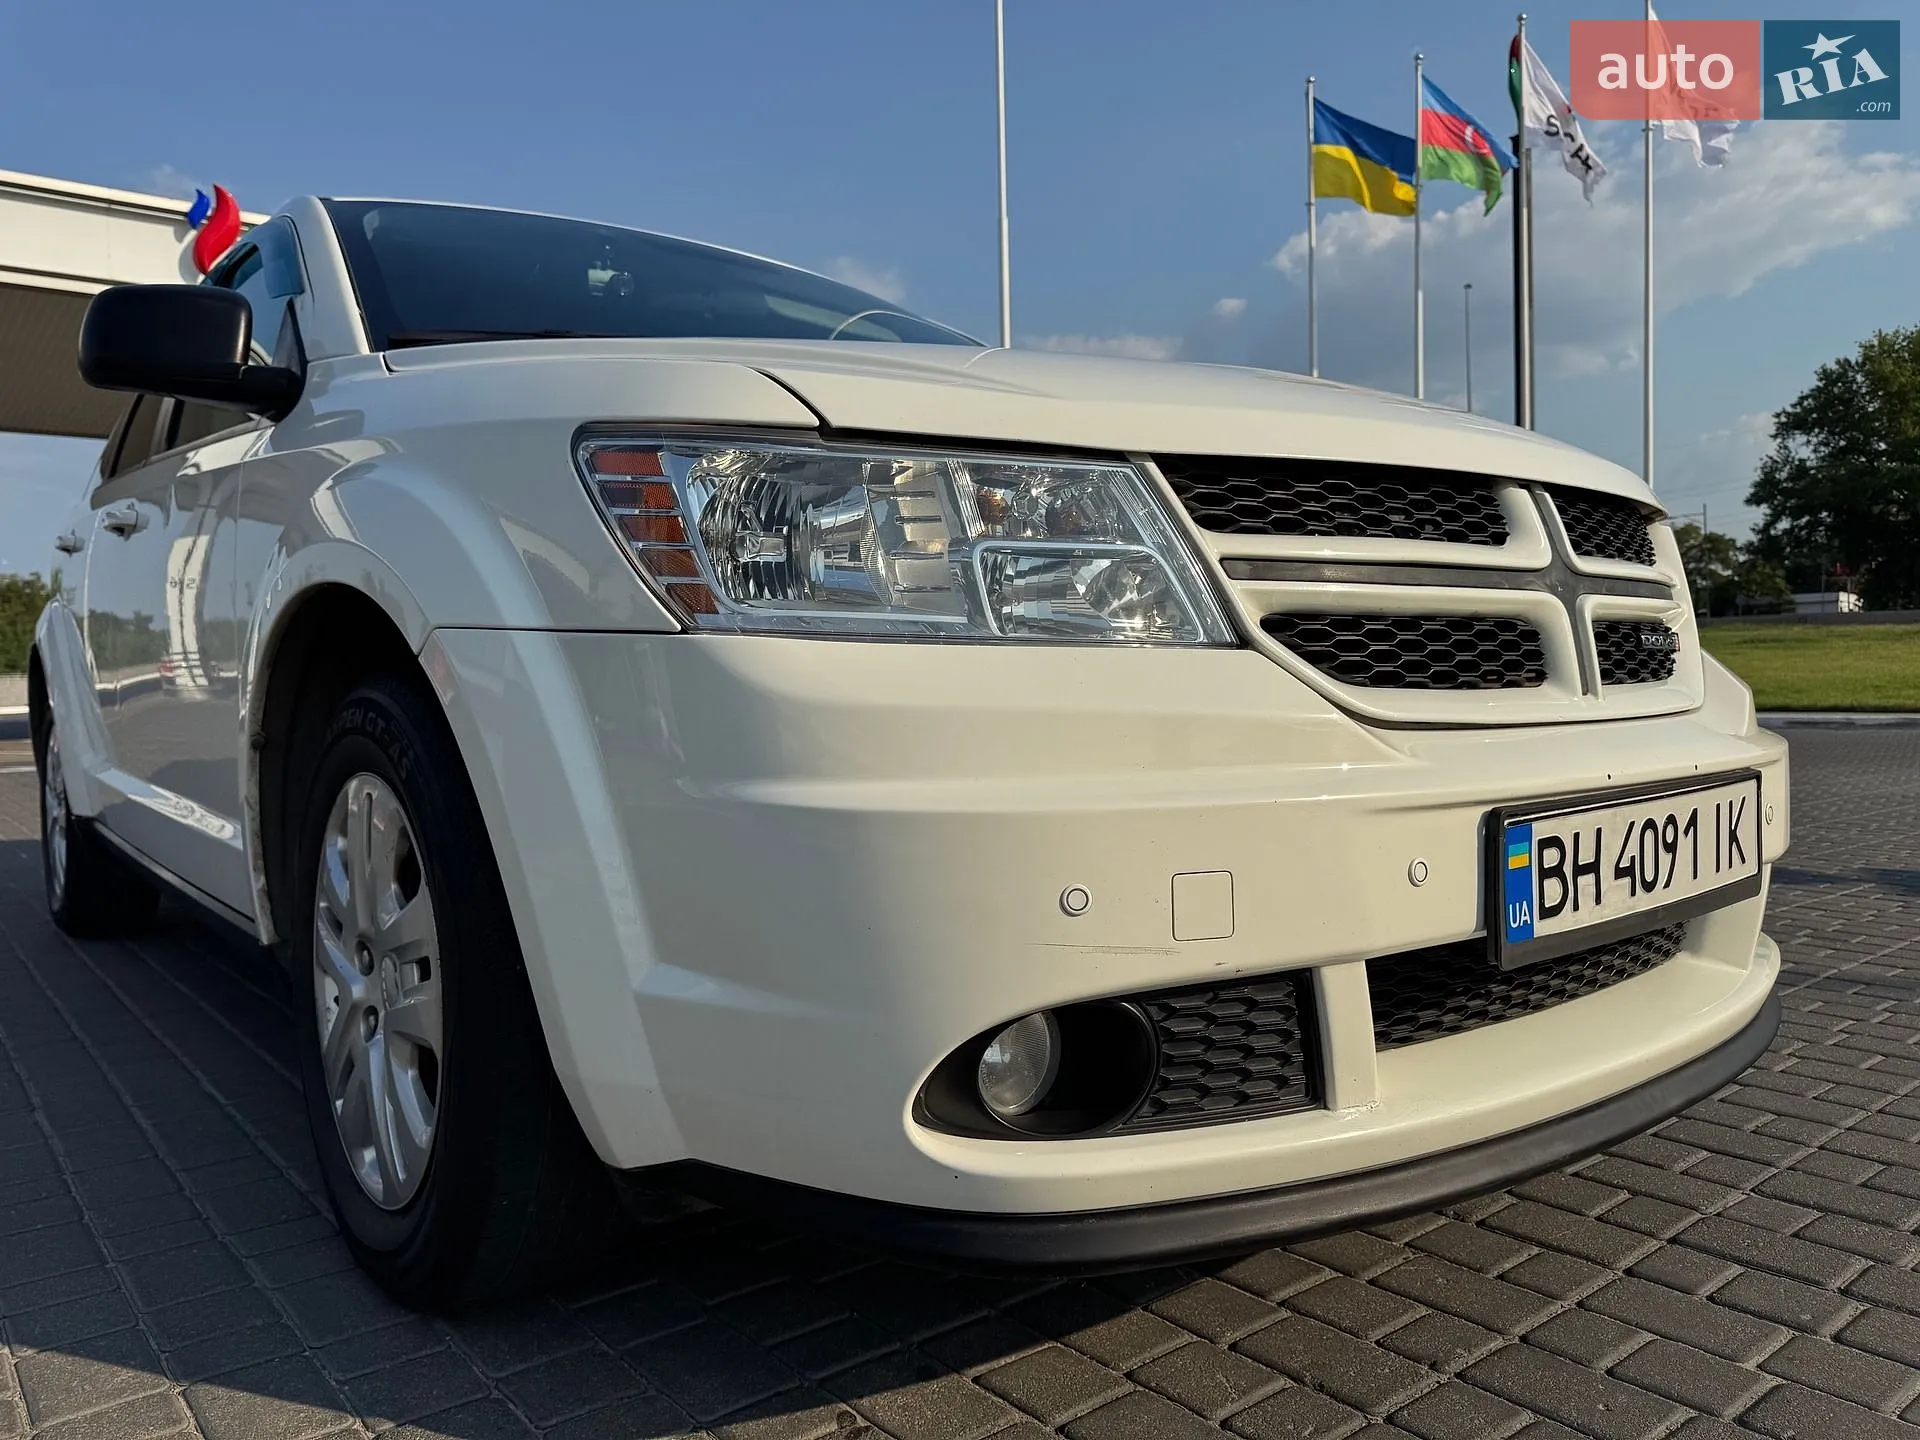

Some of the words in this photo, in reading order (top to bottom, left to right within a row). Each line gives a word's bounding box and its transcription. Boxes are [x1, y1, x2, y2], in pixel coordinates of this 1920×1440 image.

[1537, 826, 1603, 921] BH
[1613, 806, 1699, 898] 4091
[1714, 795, 1747, 874] IK
[1509, 900, 1531, 928] UA
